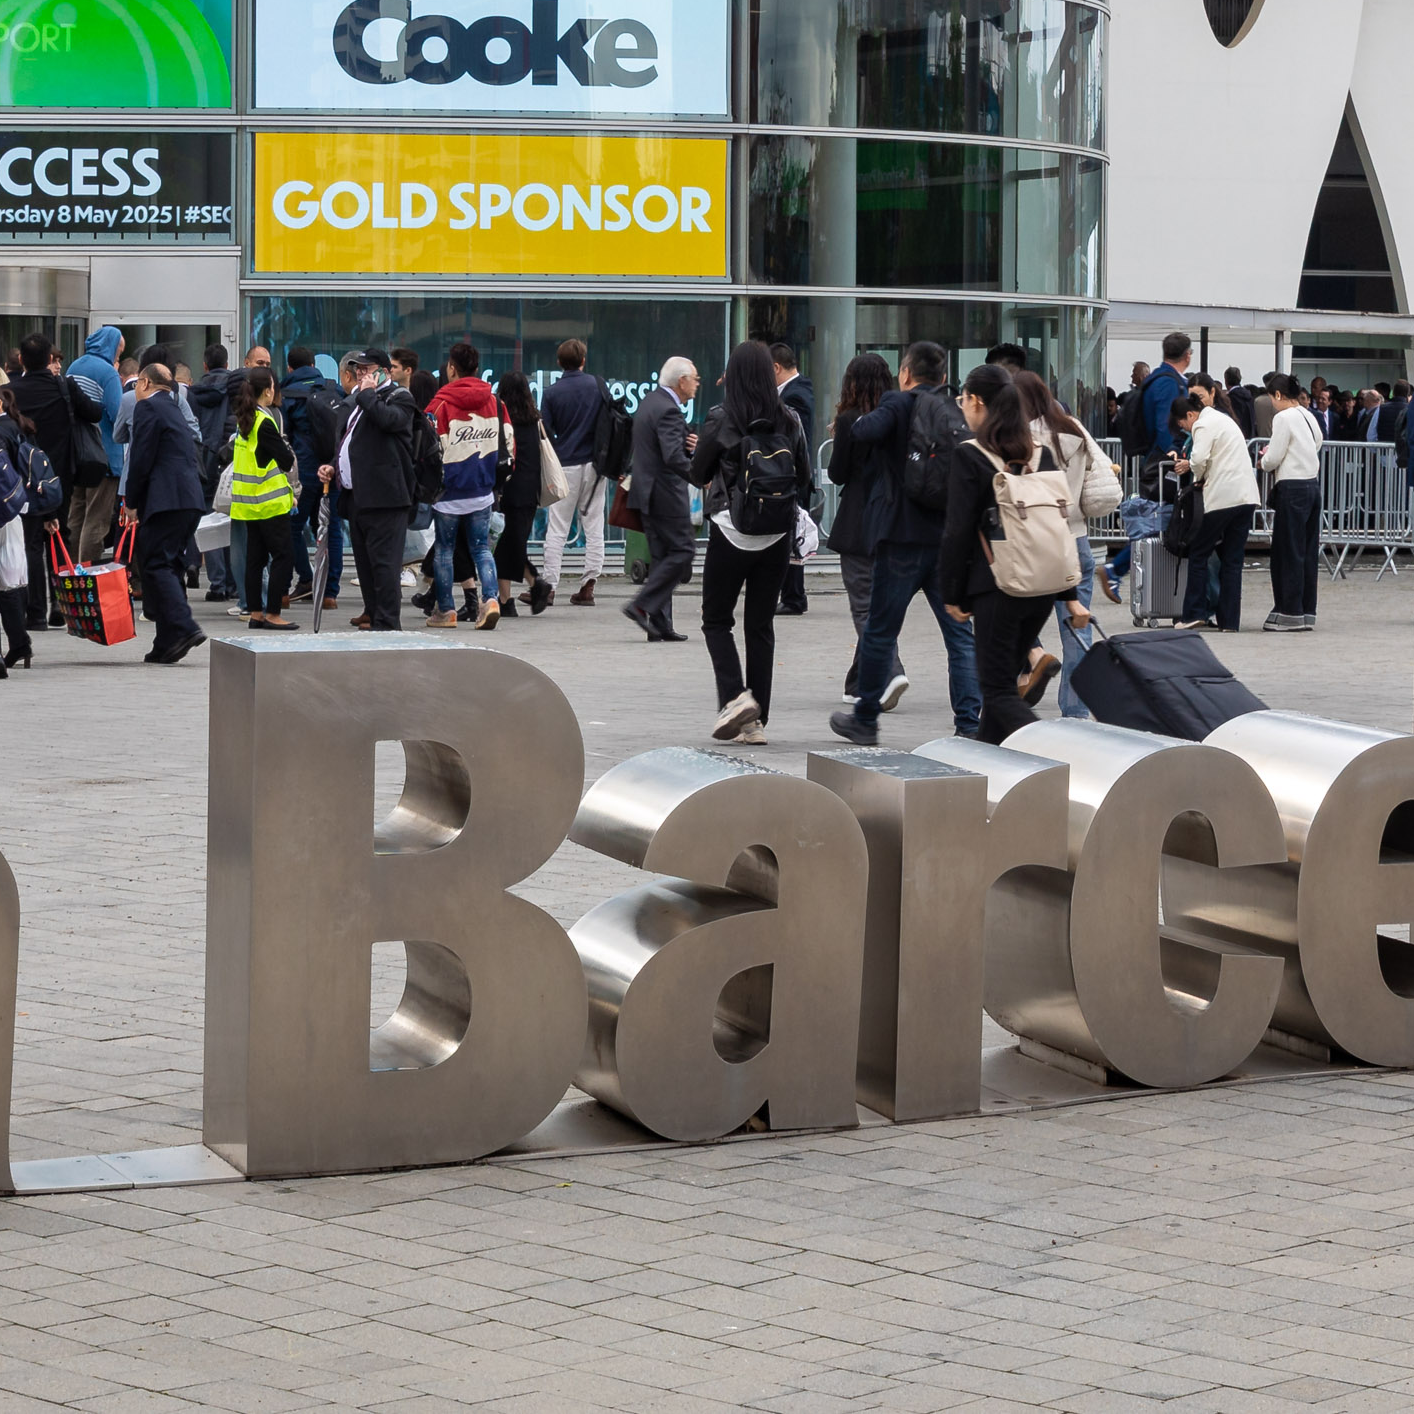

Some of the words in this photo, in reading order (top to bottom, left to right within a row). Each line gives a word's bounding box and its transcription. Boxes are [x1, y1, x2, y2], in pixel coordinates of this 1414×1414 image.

[58, 205, 71, 224] 8
[75, 205, 118, 228] May
[122, 205, 173, 224] 2025
[273, 180, 437, 229] GOLD
[449, 182, 712, 233] SPONSOR
